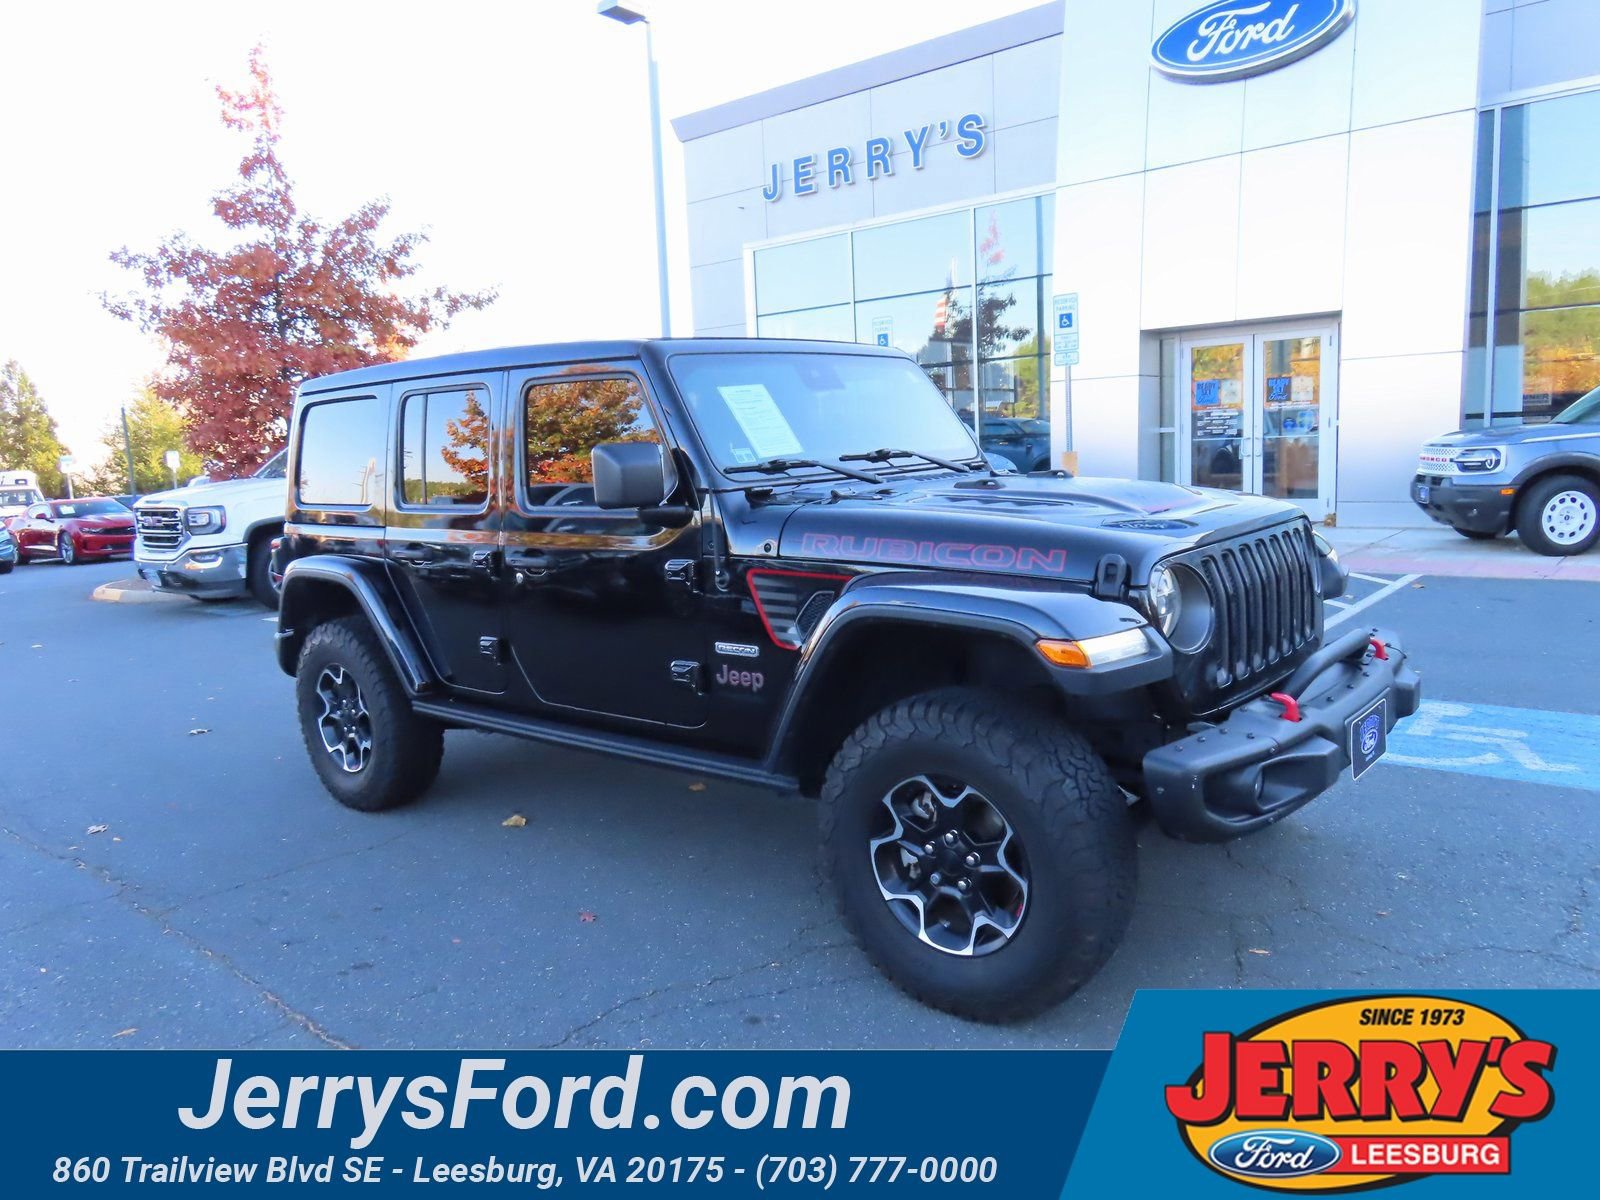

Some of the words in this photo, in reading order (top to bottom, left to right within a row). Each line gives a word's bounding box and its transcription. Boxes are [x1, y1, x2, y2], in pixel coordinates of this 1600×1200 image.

[1187, 1, 1300, 62] Ford
[762, 113, 987, 202] JERRY'S
[802, 533, 1067, 572] RUBICON
[716, 664, 764, 692] Jeep
